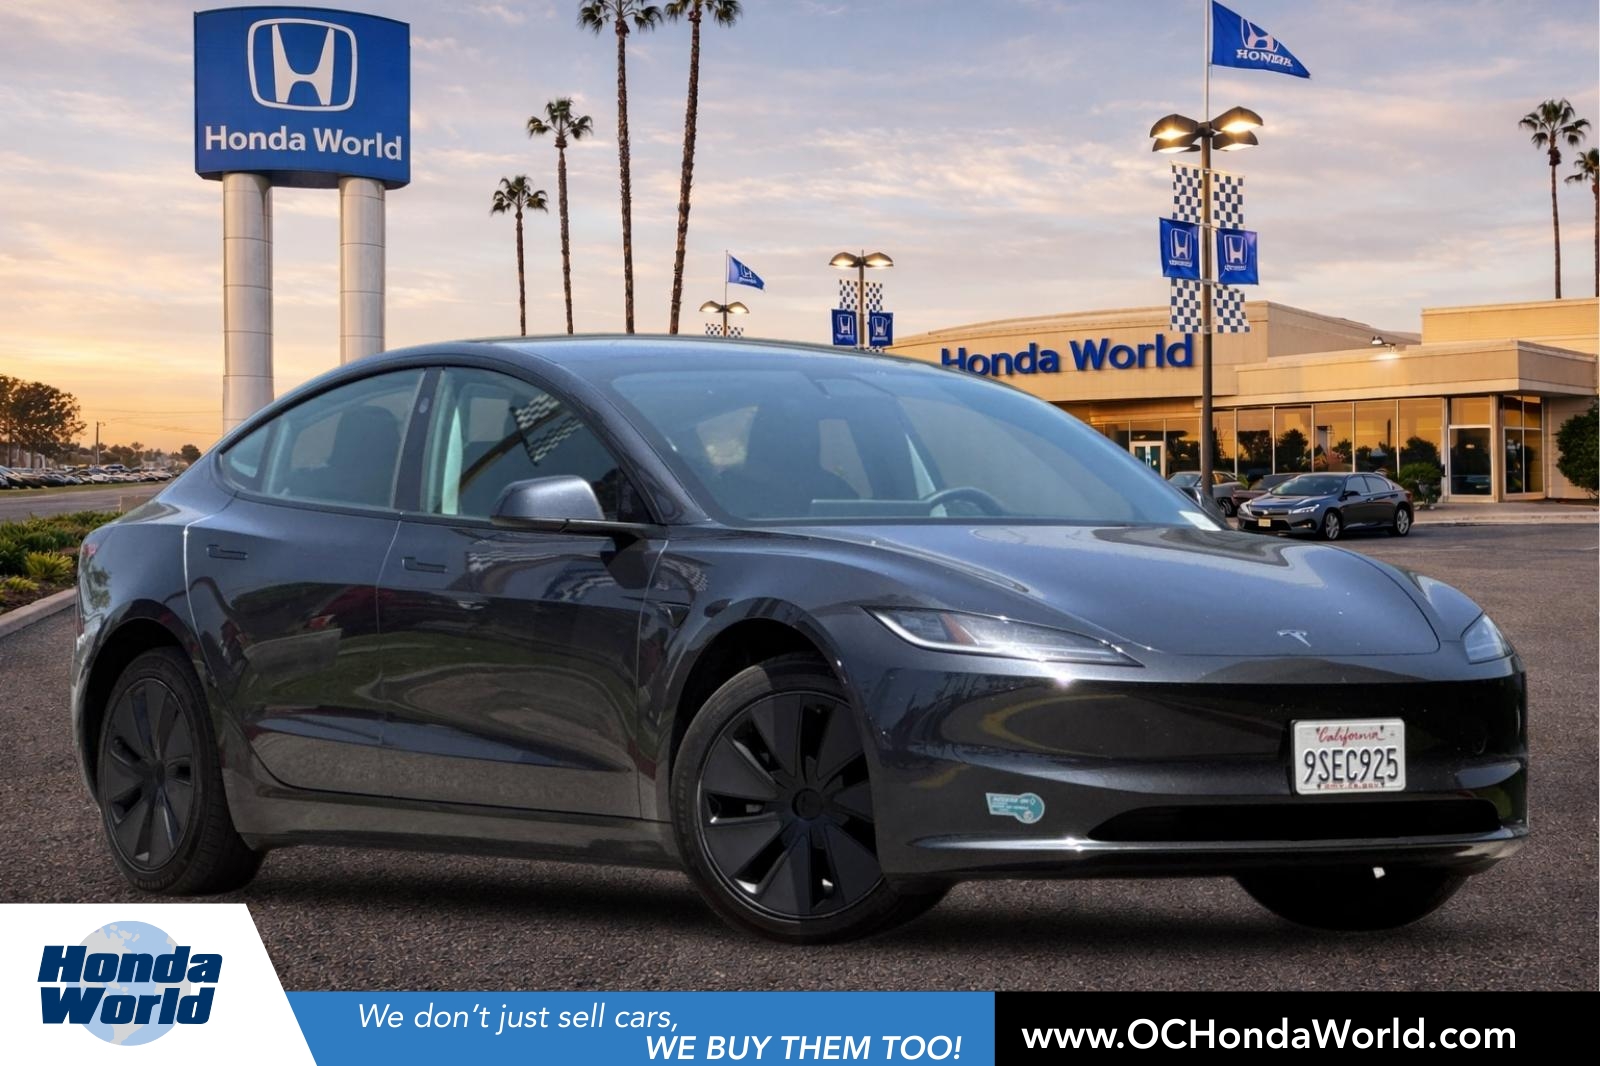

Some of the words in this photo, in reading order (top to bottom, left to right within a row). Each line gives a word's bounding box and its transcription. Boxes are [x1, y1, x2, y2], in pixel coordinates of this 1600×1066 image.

[206, 125, 306, 151] Honda
[313, 127, 402, 161] World
[941, 342, 1061, 376] Honda
[1069, 333, 1194, 371] World
[1318, 726, 1385, 746] California
[1304, 748, 1398, 784] 9SEC925
